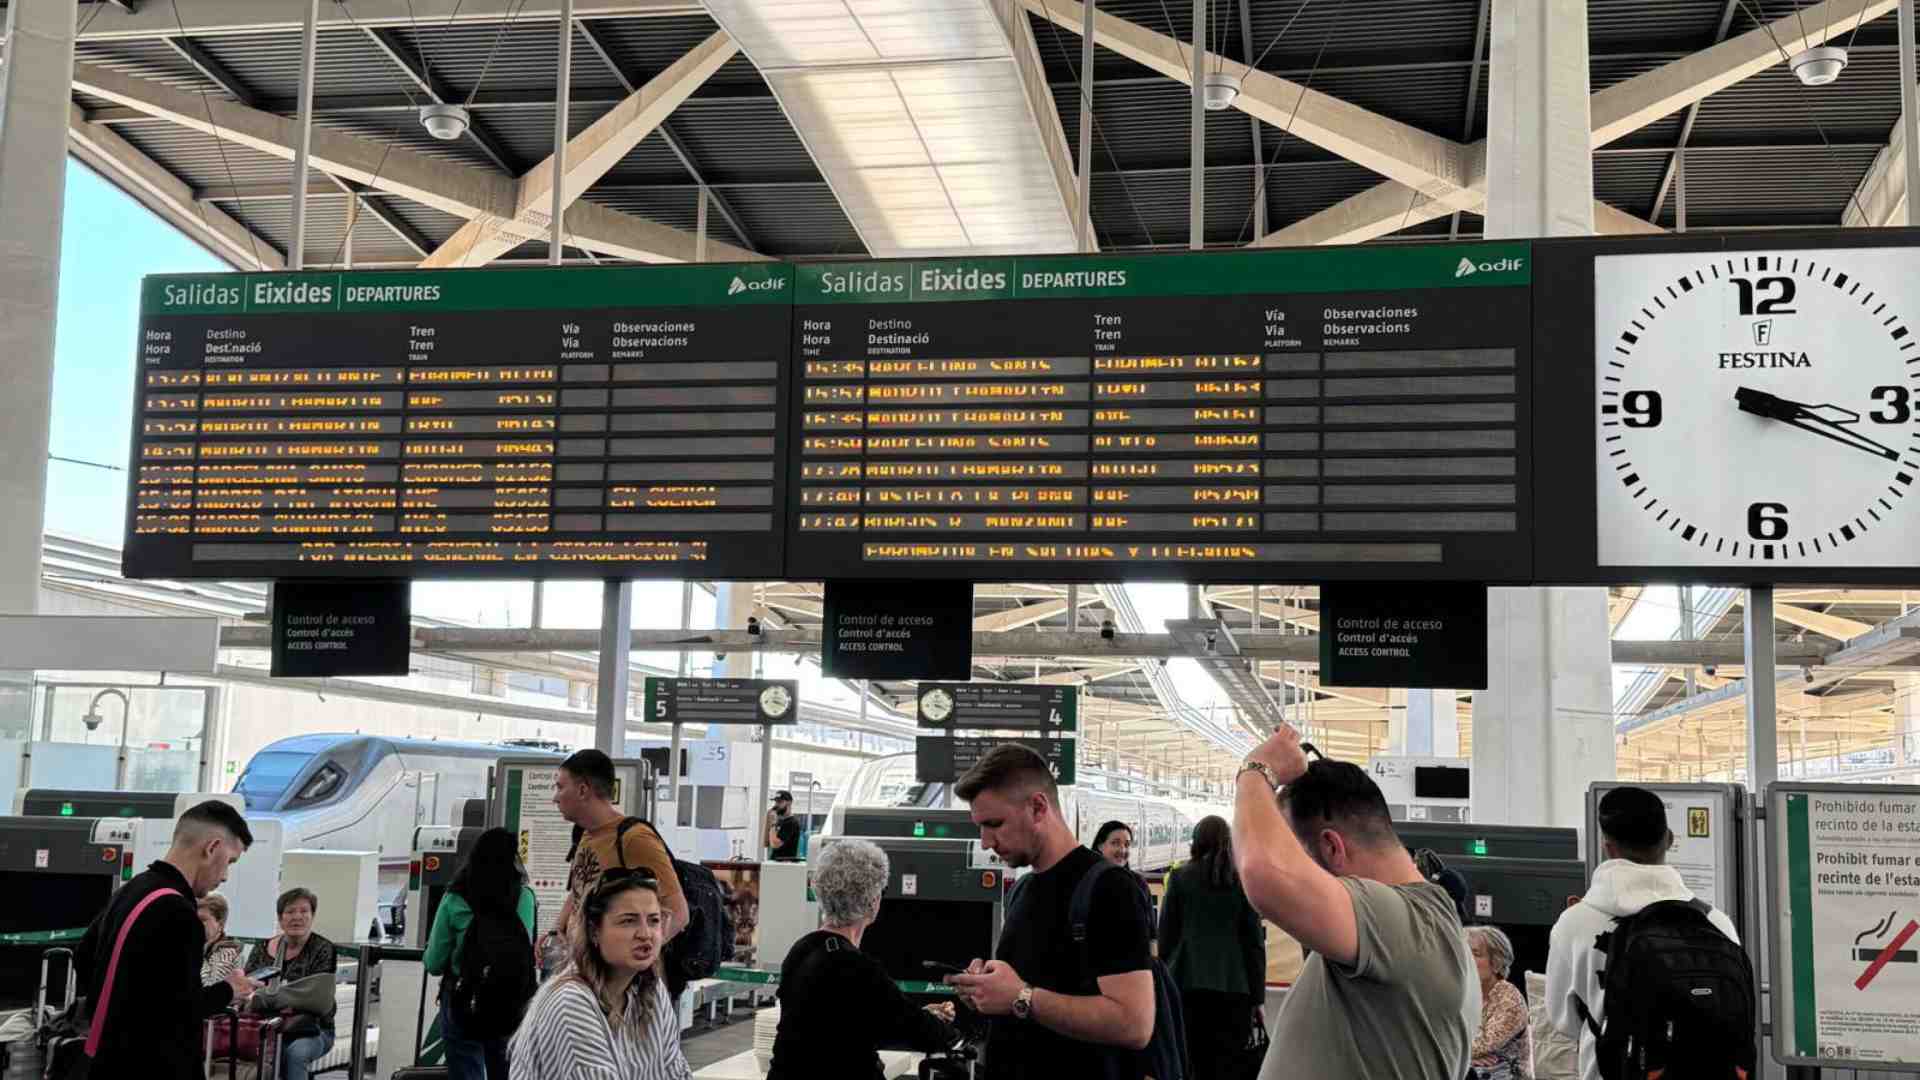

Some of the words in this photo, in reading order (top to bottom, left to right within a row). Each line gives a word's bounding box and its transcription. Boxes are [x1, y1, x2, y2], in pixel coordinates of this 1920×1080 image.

[1478, 257, 1523, 272] adif
[747, 278, 786, 291] adif
[821, 271, 904, 294] Salidas
[921, 268, 1006, 292] Eixides
[1022, 270, 1126, 288] DEPARTURES
[163, 283, 239, 306] Salidas
[254, 282, 332, 304] Eixides
[346, 285, 440, 302] DEPARTURES
[1729, 276, 1797, 316] 12
[1324, 306, 1418, 320] Observaciones
[613, 320, 695, 333] Observaciones
[803, 319, 831, 331] Hora
[869, 319, 912, 330] Destino
[1094, 314, 1121, 326] Tren
[206, 328, 246, 340] Destino
[410, 326, 435, 337] Tren
[1094, 328, 1121, 340] Tren
[1324, 321, 1410, 335] Observacions
[146, 329, 171, 341] Hora
[612, 335, 689, 347] Observacions
[803, 333, 831, 345] Hora
[868, 332, 929, 344] Destinació
[145, 343, 170, 354] Hora
[409, 340, 434, 351] Tren
[1265, 339, 1302, 347] PLATFORM
[1323, 338, 1360, 346] REMARKS
[1718, 352, 1812, 369] FESTINA
[1622, 390, 1662, 428] 9
[1869, 385, 1911, 425] 3
[1747, 502, 1789, 541] 6
[839, 615, 877, 625] Control
[880, 614, 895, 625] de
[898, 616, 934, 625] acceso
[1337, 617, 1380, 629] Control
[1384, 617, 1399, 630] de
[1402, 619, 1443, 630] acceso
[838, 628, 873, 638] Control
[1337, 632, 1375, 643] Control
[839, 642, 866, 651] ACCESS
[868, 642, 904, 651] CONTROL
[1338, 647, 1369, 656] ACCESS
[1371, 648, 1410, 657] CONTROL
[656, 700, 667, 718] 5
[1049, 708, 1062, 726] 4
[716, 746, 726, 761] 5
[1375, 762, 1385, 777] 4
[1815, 800, 1875, 814] Prohibido
[1879, 800, 1916, 814] fumar
[1816, 819, 1858, 832] recinto
[1862, 820, 1878, 832] de
[1882, 820, 1893, 832] la
[1817, 852, 1868, 865] Prohibit
[1872, 853, 1911, 866] fumar
[1818, 870, 1861, 885] recinte
[1865, 872, 1881, 885] de
